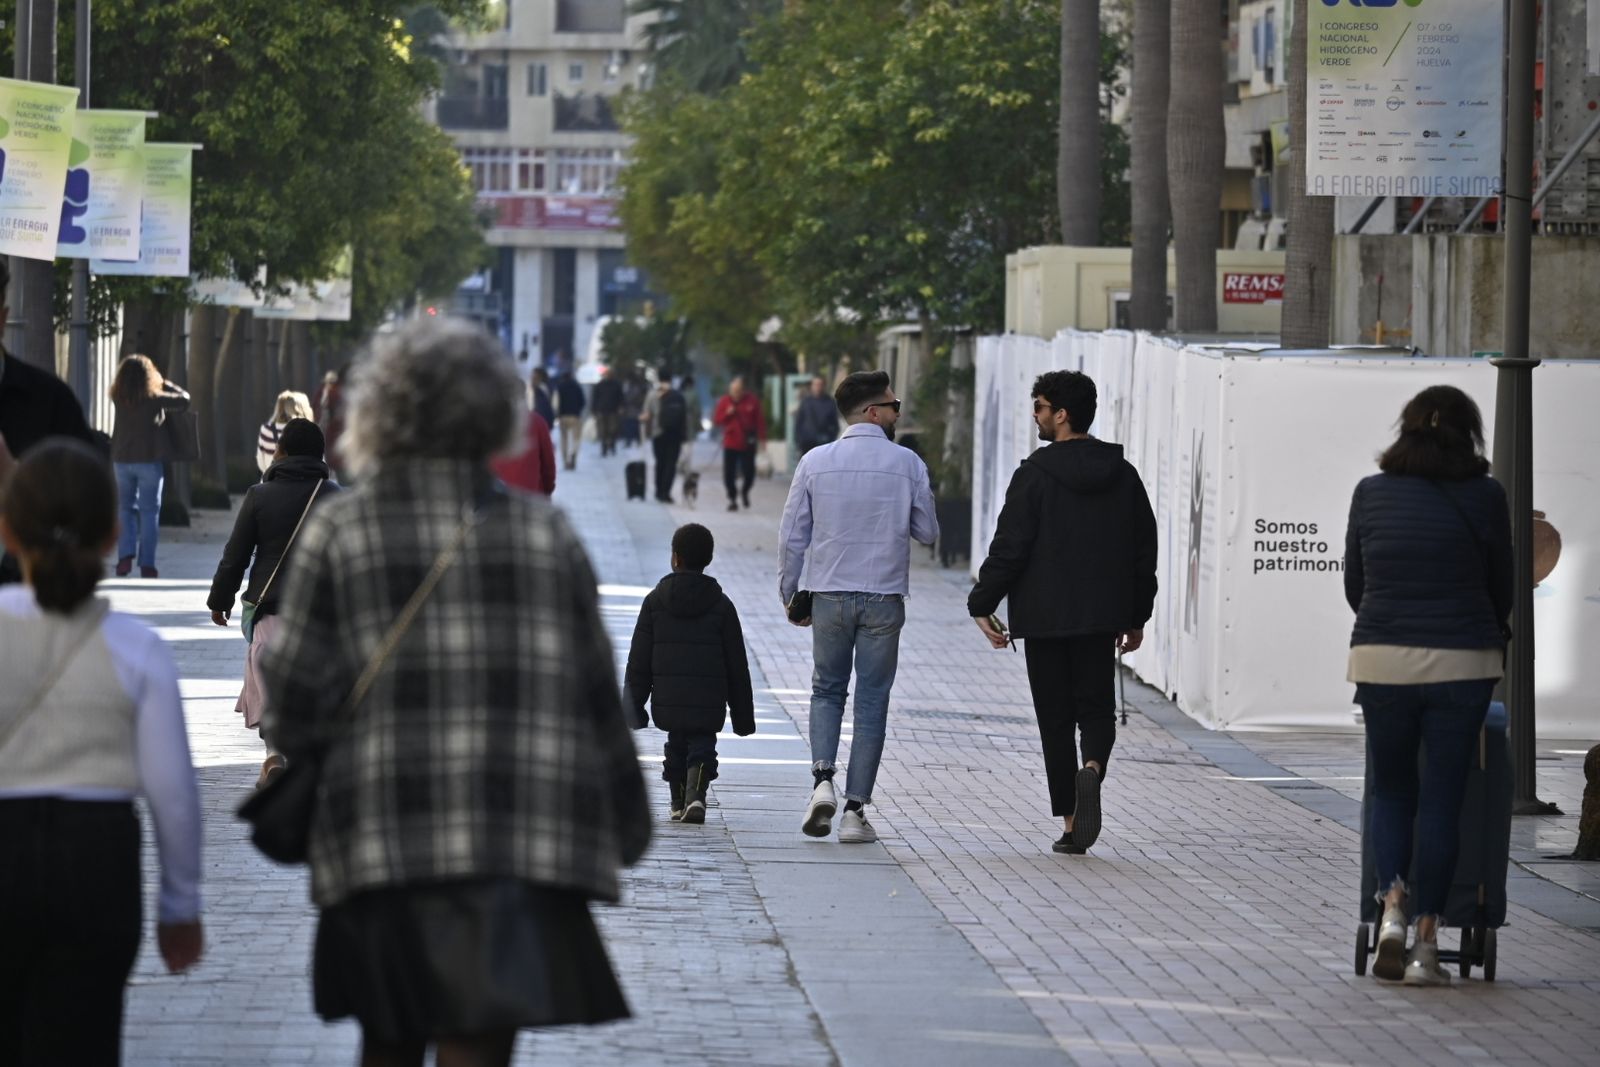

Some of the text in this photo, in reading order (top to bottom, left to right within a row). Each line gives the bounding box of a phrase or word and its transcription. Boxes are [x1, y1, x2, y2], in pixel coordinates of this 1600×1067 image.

[1324, 22, 1379, 31] CONGRESO
[1416, 23, 1430, 31] 07
[1438, 23, 1453, 31] 09
[1319, 34, 1368, 43] NACIONAL
[1416, 34, 1459, 43] FEBRERO
[1319, 45, 1378, 55] HIDRÓGENO
[1416, 46, 1441, 55] 2024
[1319, 57, 1352, 66] VERDE
[1416, 58, 1452, 67] HUELVA
[15, 111, 57, 123] NACIONAL
[1307, 175, 1501, 197] A ENERGIA QUE SUMA
[13, 218, 49, 233] ENERGIA
[1254, 518, 1318, 535] Somos
[1254, 538, 1328, 553] nuestro
[1253, 555, 1345, 575] patrimoni
